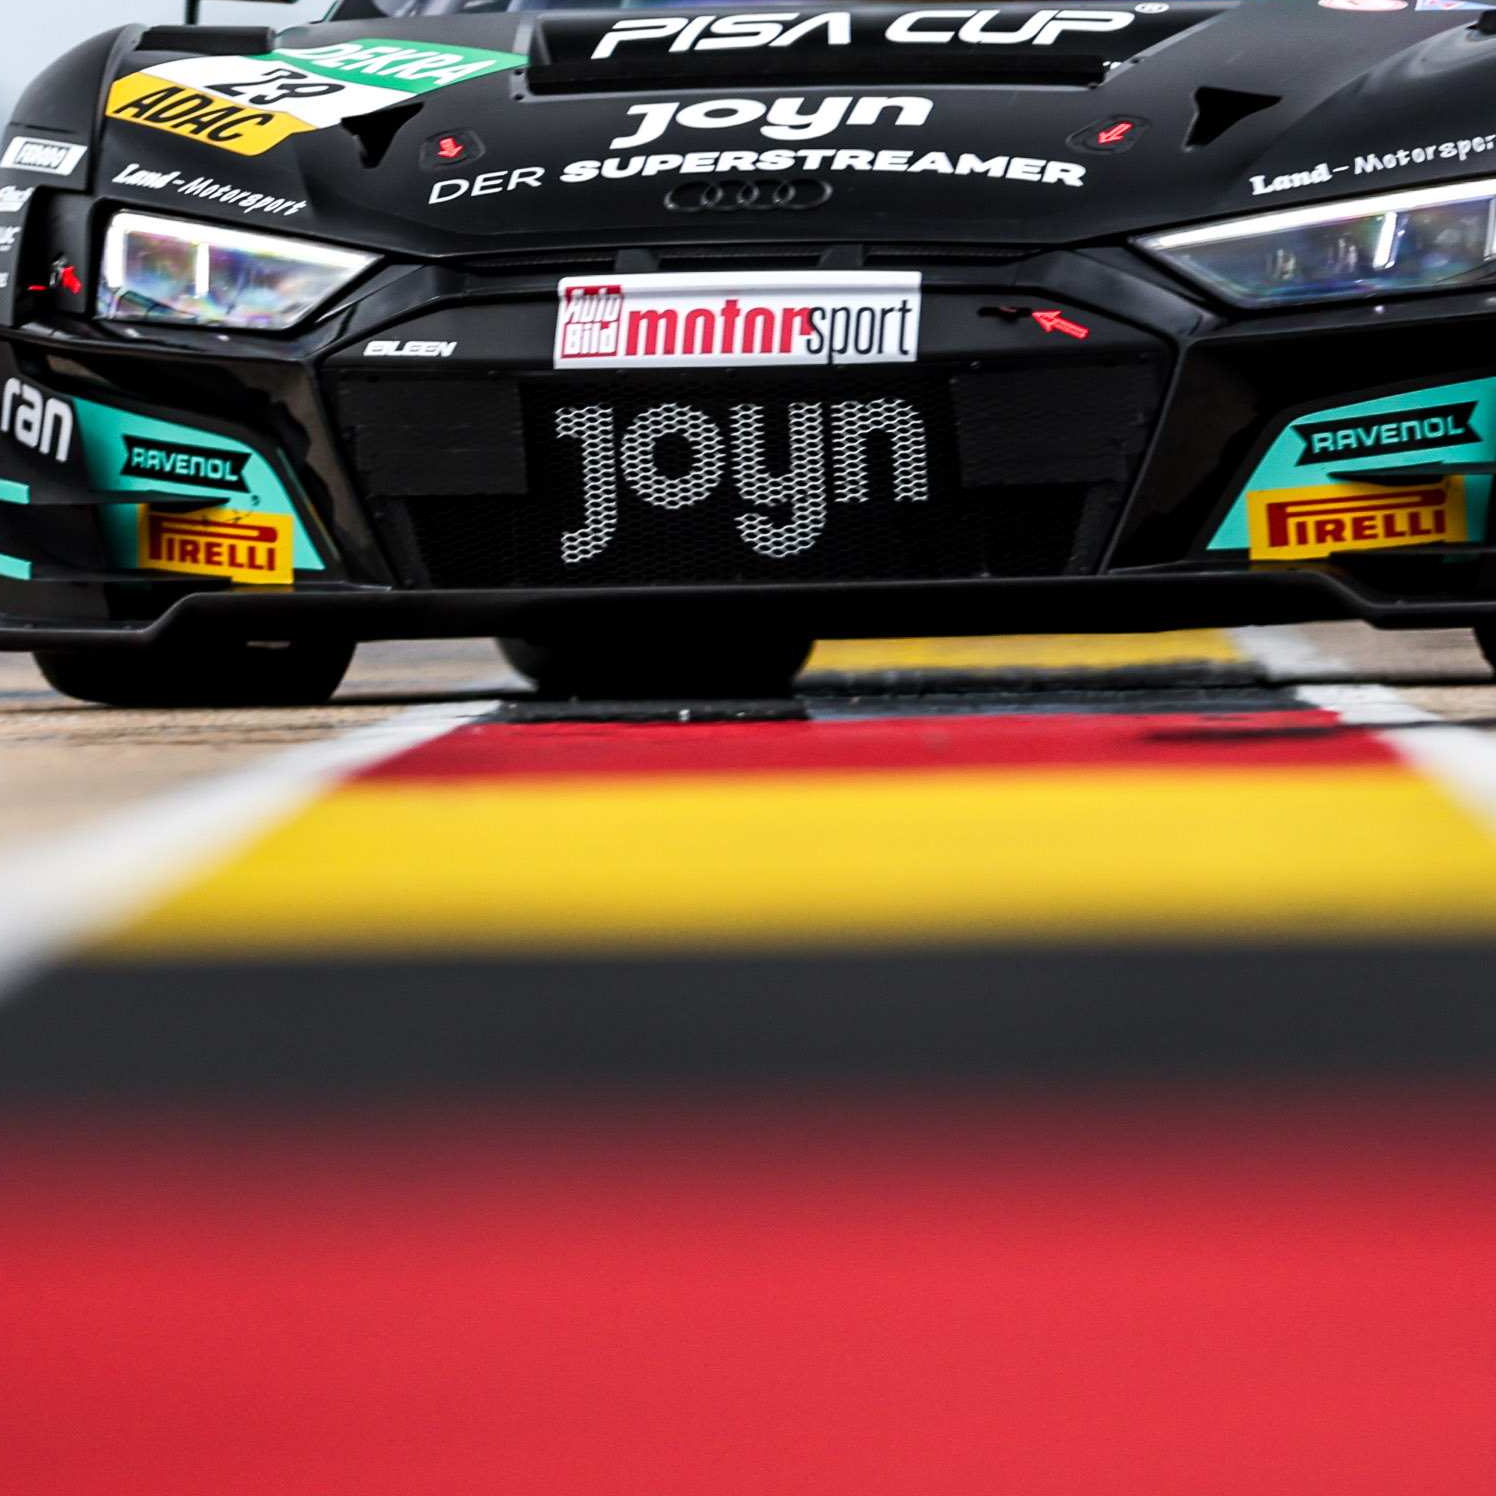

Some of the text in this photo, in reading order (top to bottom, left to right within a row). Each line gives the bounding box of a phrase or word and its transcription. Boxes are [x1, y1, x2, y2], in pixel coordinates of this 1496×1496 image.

[591, 9, 1136, 60] PISA CUP
[204, 68, 346, 106] 29
[298, 43, 497, 86] DEKRA
[113, 86, 275, 142] ADAC
[428, 149, 1087, 204] DER SUPERSTREAMER
[563, 321, 619, 355] Bild
[625, 298, 912, 365] motorsport
[0, 377, 74, 463] ran
[1311, 415, 1465, 454] RAVENOL
[131, 446, 240, 482] RAVENOL
[148, 513, 278, 572] PIRELLI
[1266, 488, 1448, 548] PIRELLI
